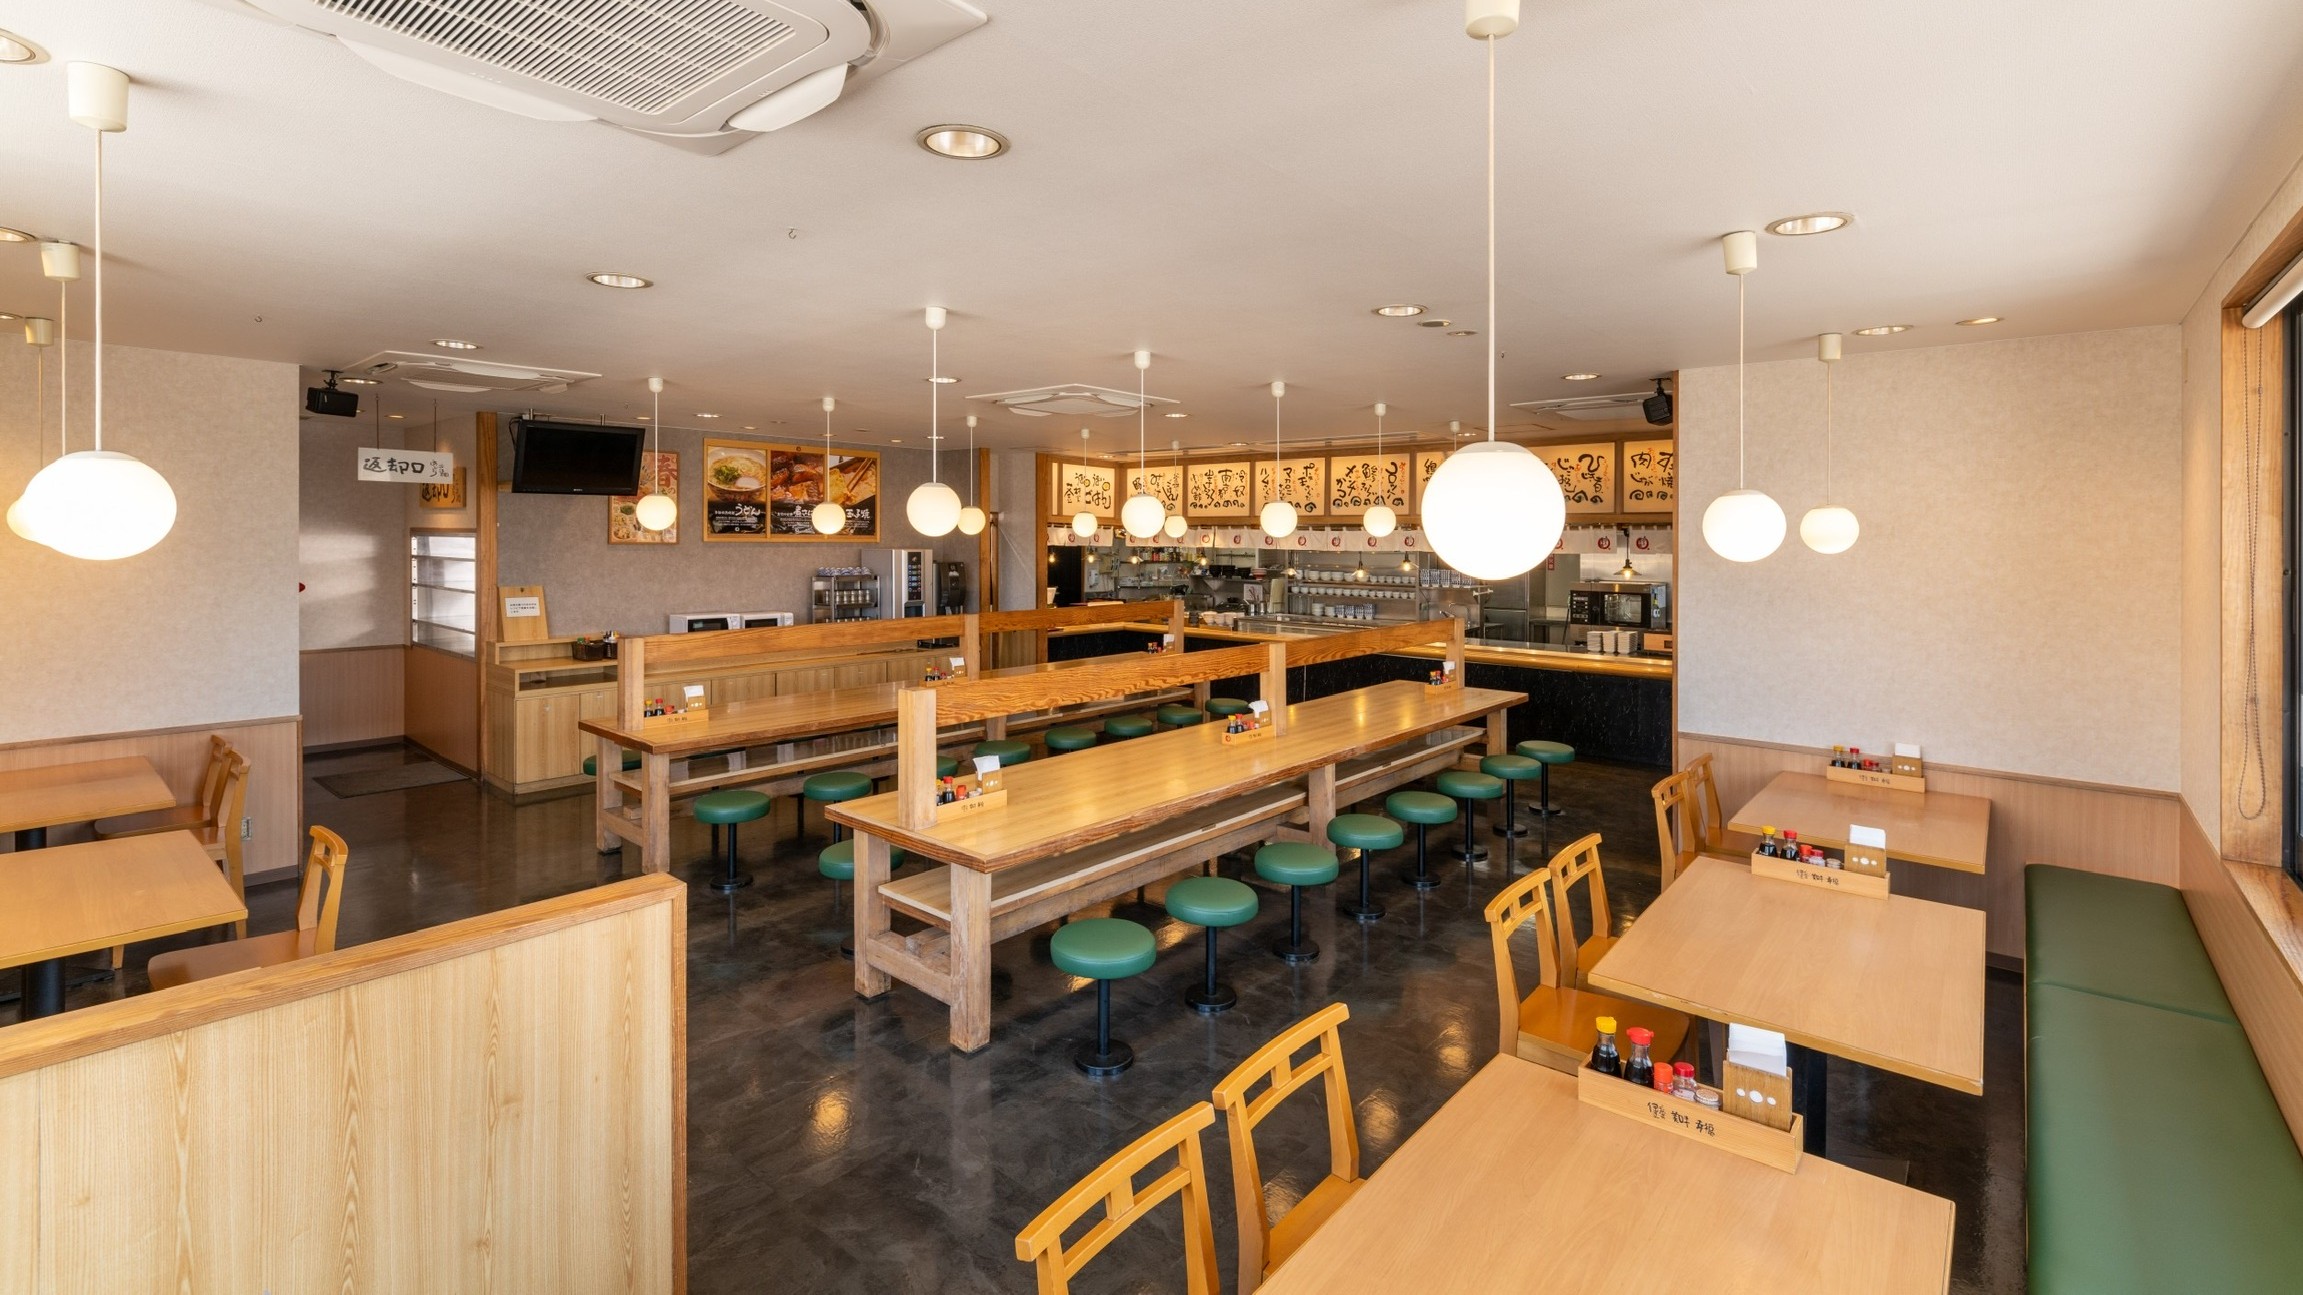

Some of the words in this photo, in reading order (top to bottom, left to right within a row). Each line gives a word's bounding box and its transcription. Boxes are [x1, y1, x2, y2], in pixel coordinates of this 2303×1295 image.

[363, 457, 425, 475] 返却口
[1630, 451, 1654, 487] 肉じゃが
[1232, 469, 1247, 498] 冷奴
[735, 503, 761, 516] うどん
